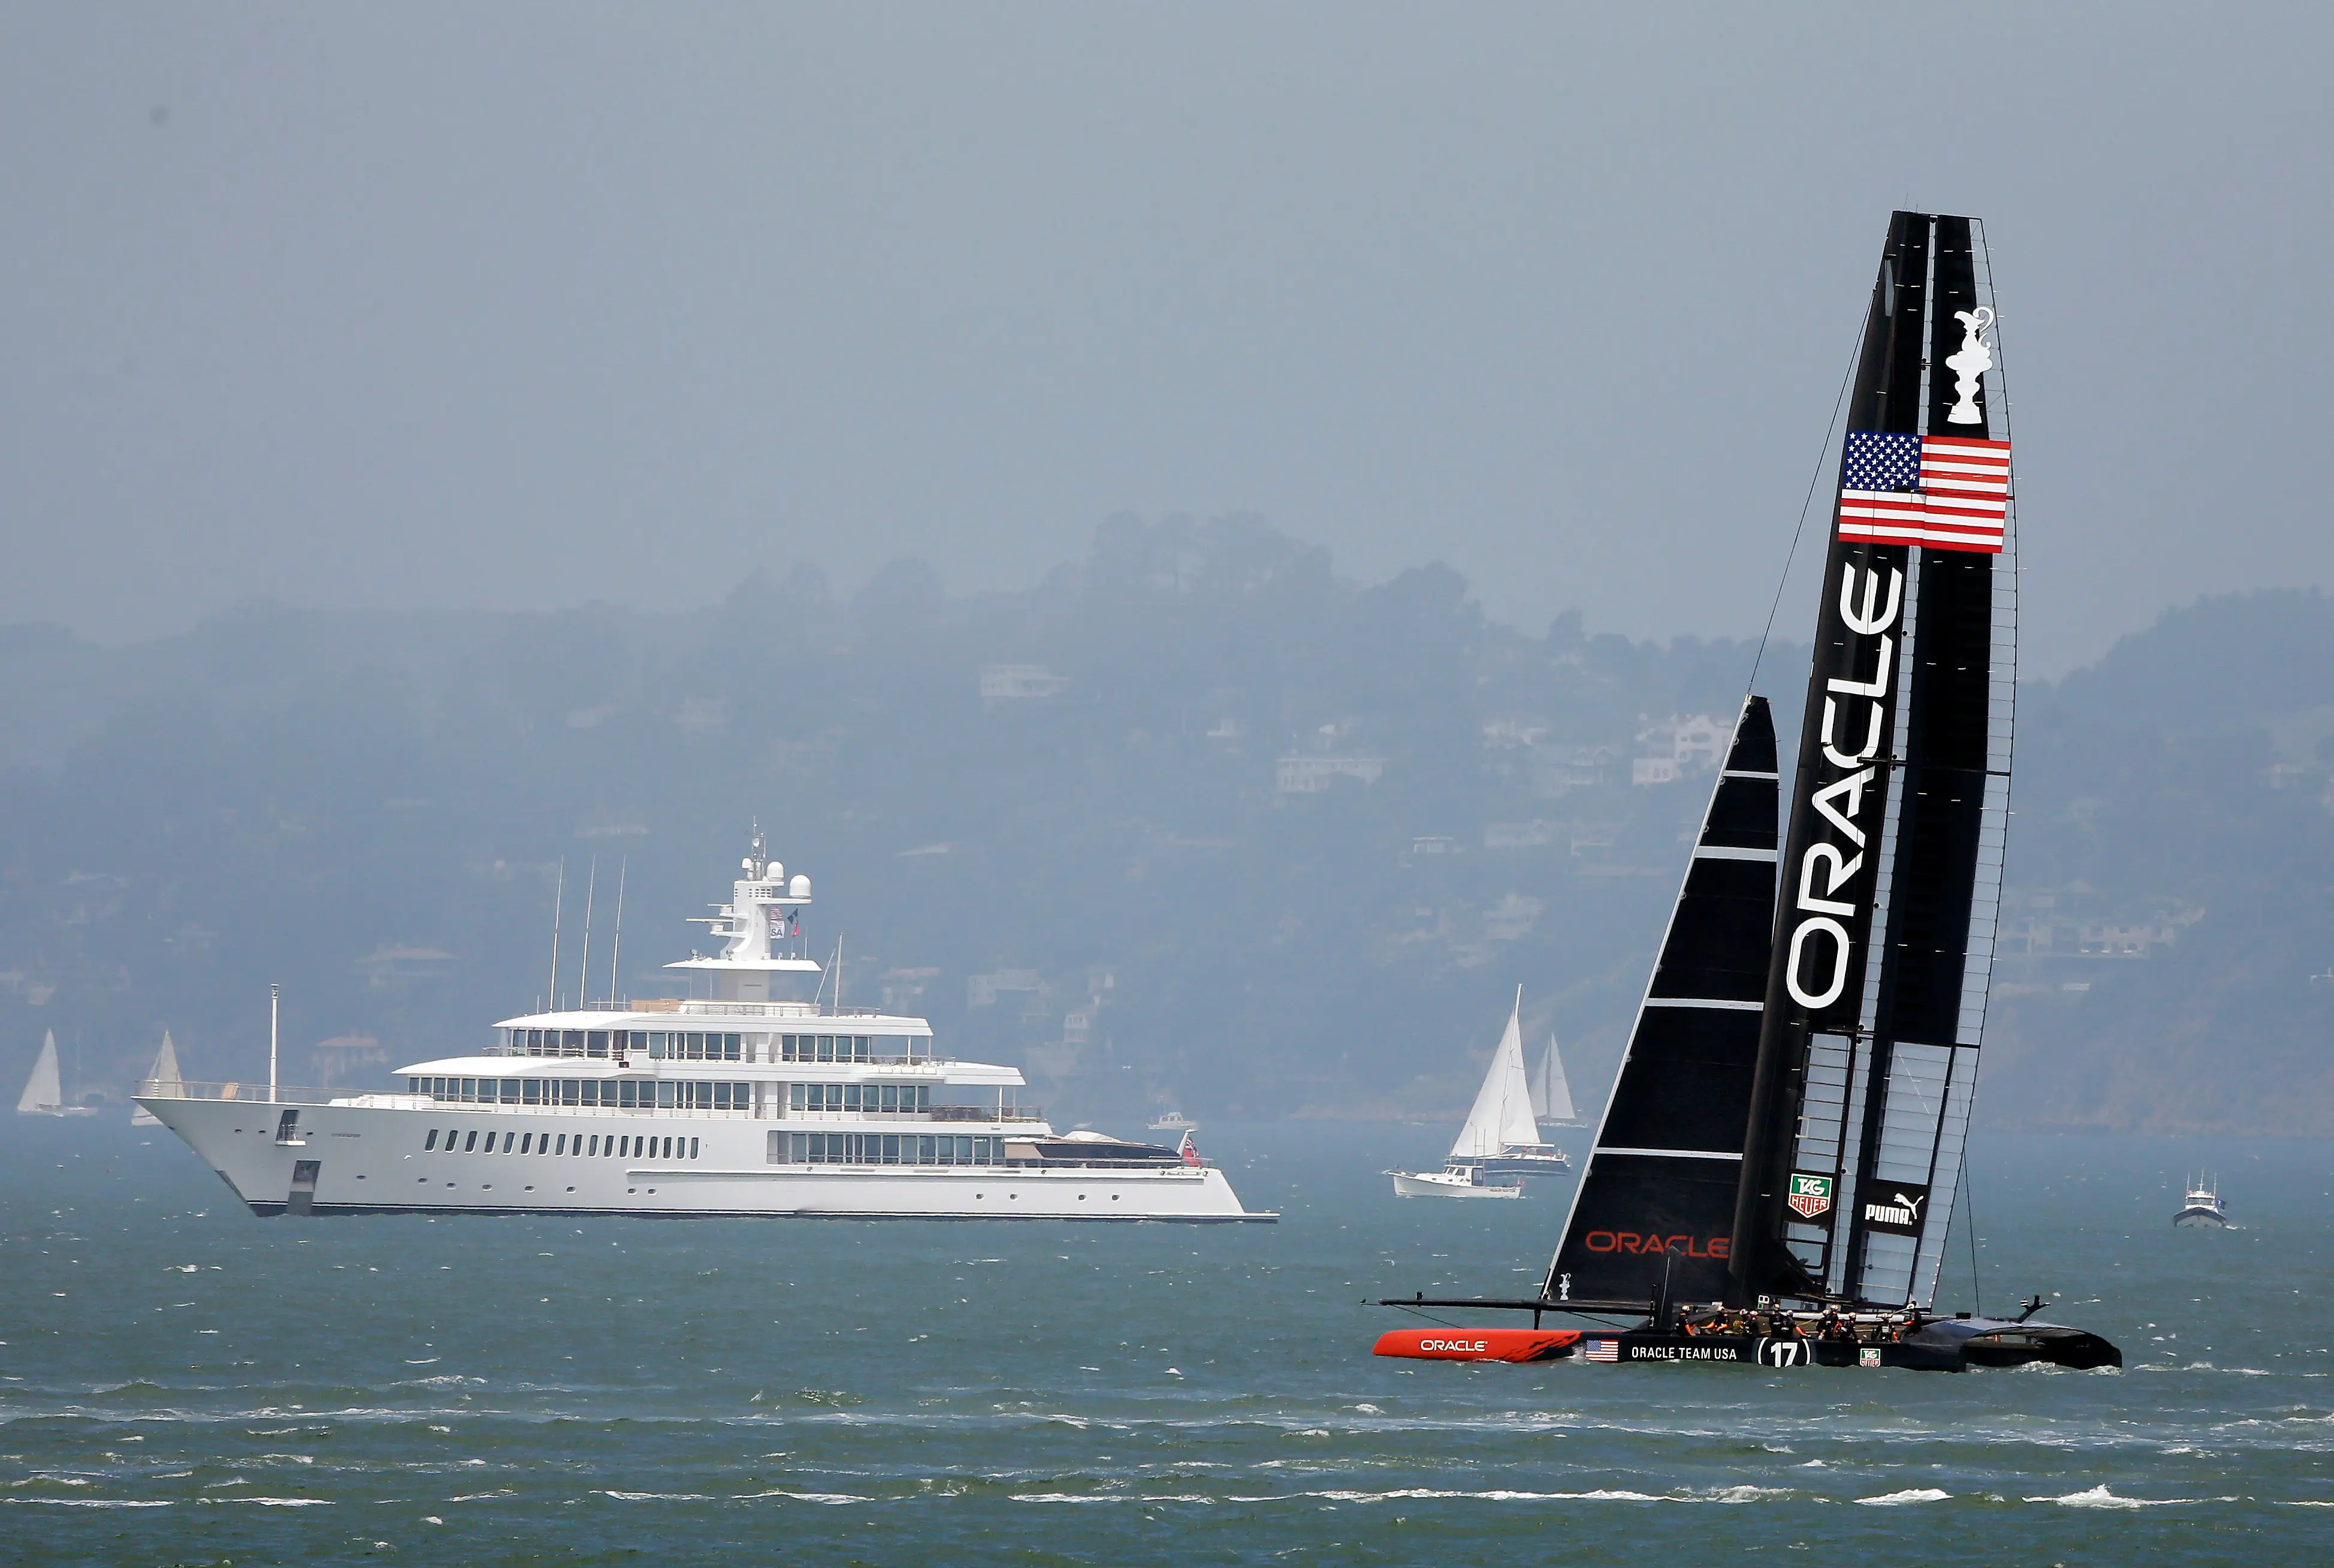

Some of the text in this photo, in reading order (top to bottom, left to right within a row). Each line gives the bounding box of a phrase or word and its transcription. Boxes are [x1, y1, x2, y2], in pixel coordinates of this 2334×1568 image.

[1786, 561, 1902, 1009] ORACLE
[771, 928, 783, 936] SA
[1798, 1178, 1825, 1196] TAG
[1792, 1196, 1827, 1214] HEUER
[1865, 1204, 1910, 1225] PUMA
[1585, 1231, 1732, 1258] ORACLE
[1420, 1339, 1486, 1352] ORACLE
[1632, 1346, 1737, 1360] ORACLE TEAM USA
[1863, 1350, 1877, 1359] TAG
